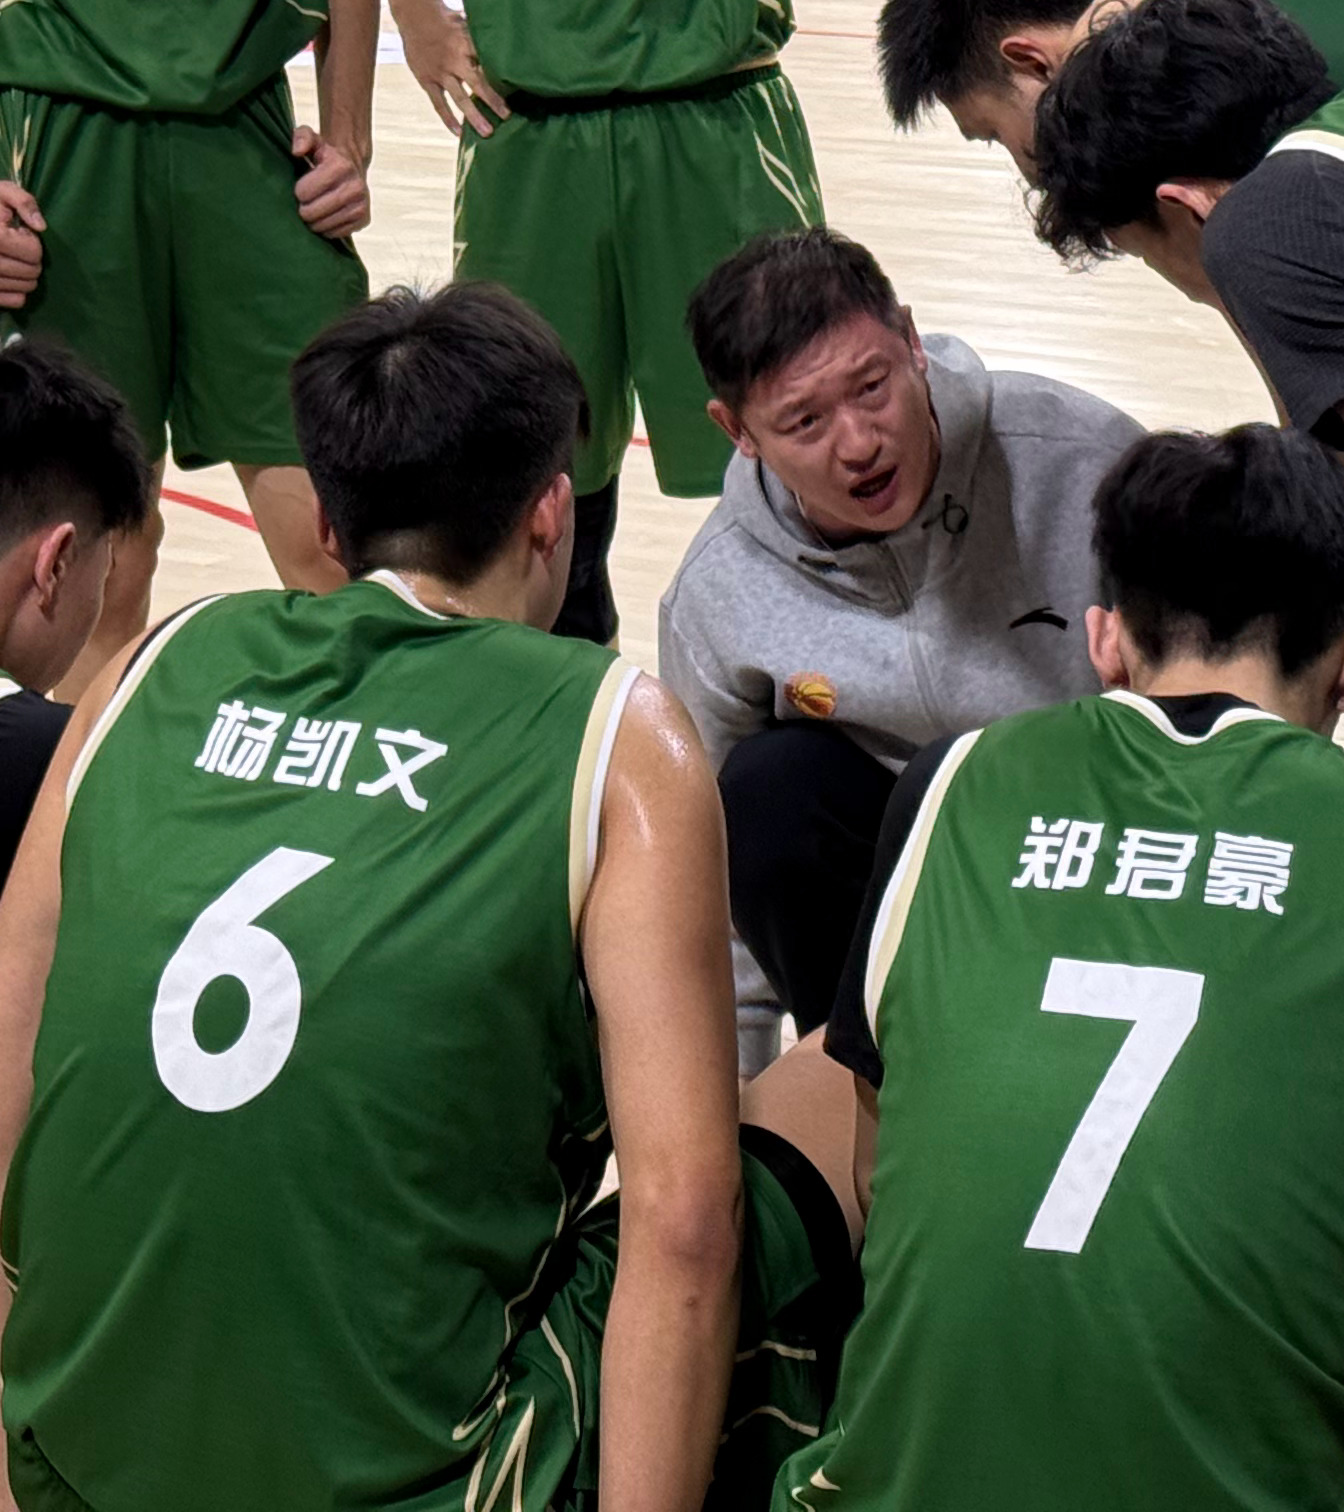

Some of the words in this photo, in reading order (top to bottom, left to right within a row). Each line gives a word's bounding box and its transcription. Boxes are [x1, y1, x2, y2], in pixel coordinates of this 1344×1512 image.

[194, 699, 449, 812] 杨凯文
[1011, 816, 1295, 916] 郑君豪
[151, 845, 336, 1113] 6
[1024, 957, 1205, 1254] 7
